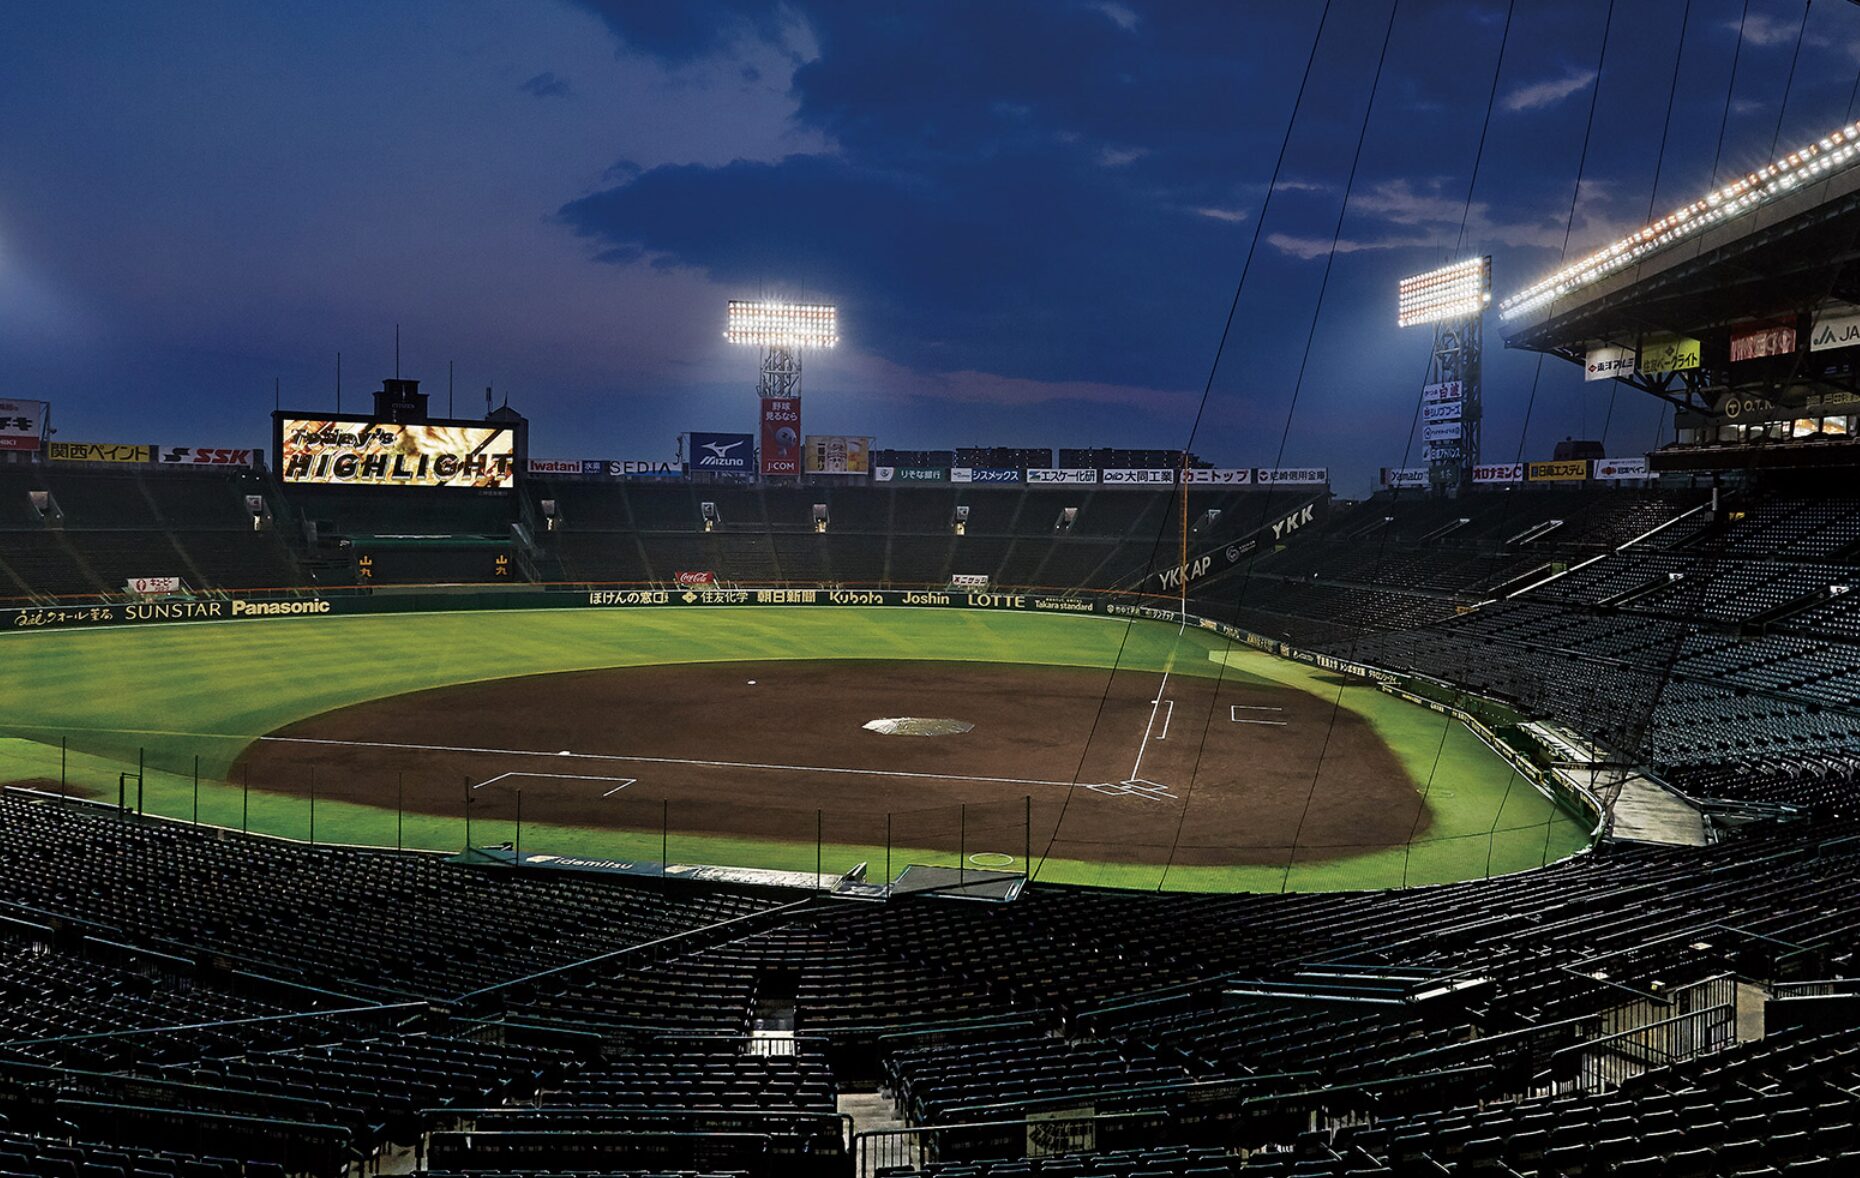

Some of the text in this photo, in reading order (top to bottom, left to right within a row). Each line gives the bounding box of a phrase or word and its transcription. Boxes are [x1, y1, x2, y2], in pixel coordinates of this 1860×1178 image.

[772, 402, 790, 411] 野球
[766, 411, 798, 421] 見るなら
[291, 428, 395, 449] Today's
[50, 442, 149, 462] 関西ペイント
[193, 448, 250, 464] SSK
[284, 452, 514, 481] HIGHLIGHT
[530, 459, 580, 472] Iwatani
[609, 460, 672, 476] SEDIA
[1473, 465, 1521, 480] オロナミンC
[900, 469, 941, 480] りそな銀行
[972, 469, 1019, 481] シスメックス
[1041, 469, 1096, 482] エスケー化研
[1124, 470, 1172, 482] 大同工業
[1182, 470, 1248, 482] カニトップ
[1391, 470, 1424, 482] Yamato
[1271, 503, 1314, 540] YKK
[359, 555, 373, 578] 山九
[495, 554, 508, 576] 山九
[1159, 555, 1212, 591] YKK AP
[589, 591, 665, 605] ほけんの窓口
[700, 591, 749, 604] 住友化学
[756, 591, 817, 604] 朝日新聞
[829, 590, 884, 605] Kubota
[902, 591, 950, 605] Joshin
[968, 593, 1025, 608] LOTTE
[1034, 599, 1059, 609] Takara
[1060, 602, 1094, 611] standard
[124, 602, 222, 620] SUNSTAR
[231, 599, 331, 616] Panasonic
[554, 855, 634, 870] idemitsu
